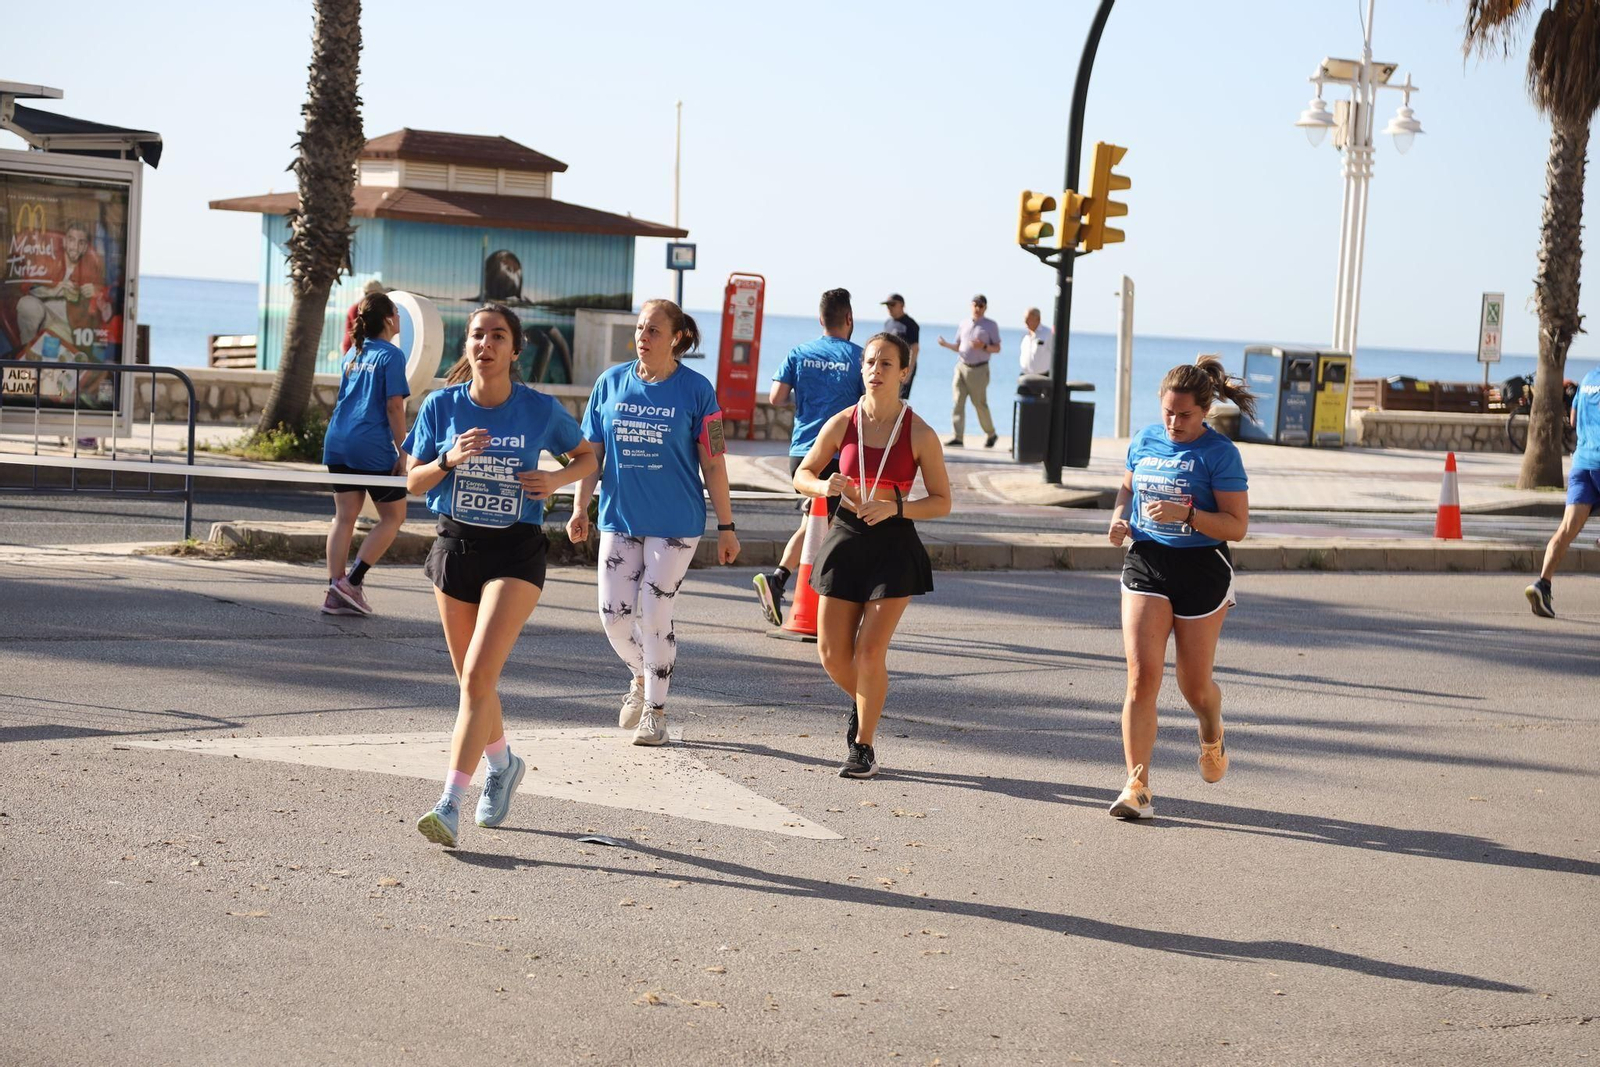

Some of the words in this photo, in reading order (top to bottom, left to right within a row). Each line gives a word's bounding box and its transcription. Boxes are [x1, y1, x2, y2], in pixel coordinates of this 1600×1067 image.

[803, 358, 850, 372] mayoral
[614, 402, 676, 418] mayoral
[612, 419, 669, 432] RUNNING
[617, 427, 663, 438] MAKES
[616, 434, 663, 445] FRIENDS
[1138, 456, 1195, 472] mayoral
[1135, 474, 1187, 487] RUNNING
[461, 493, 513, 513] 2026
